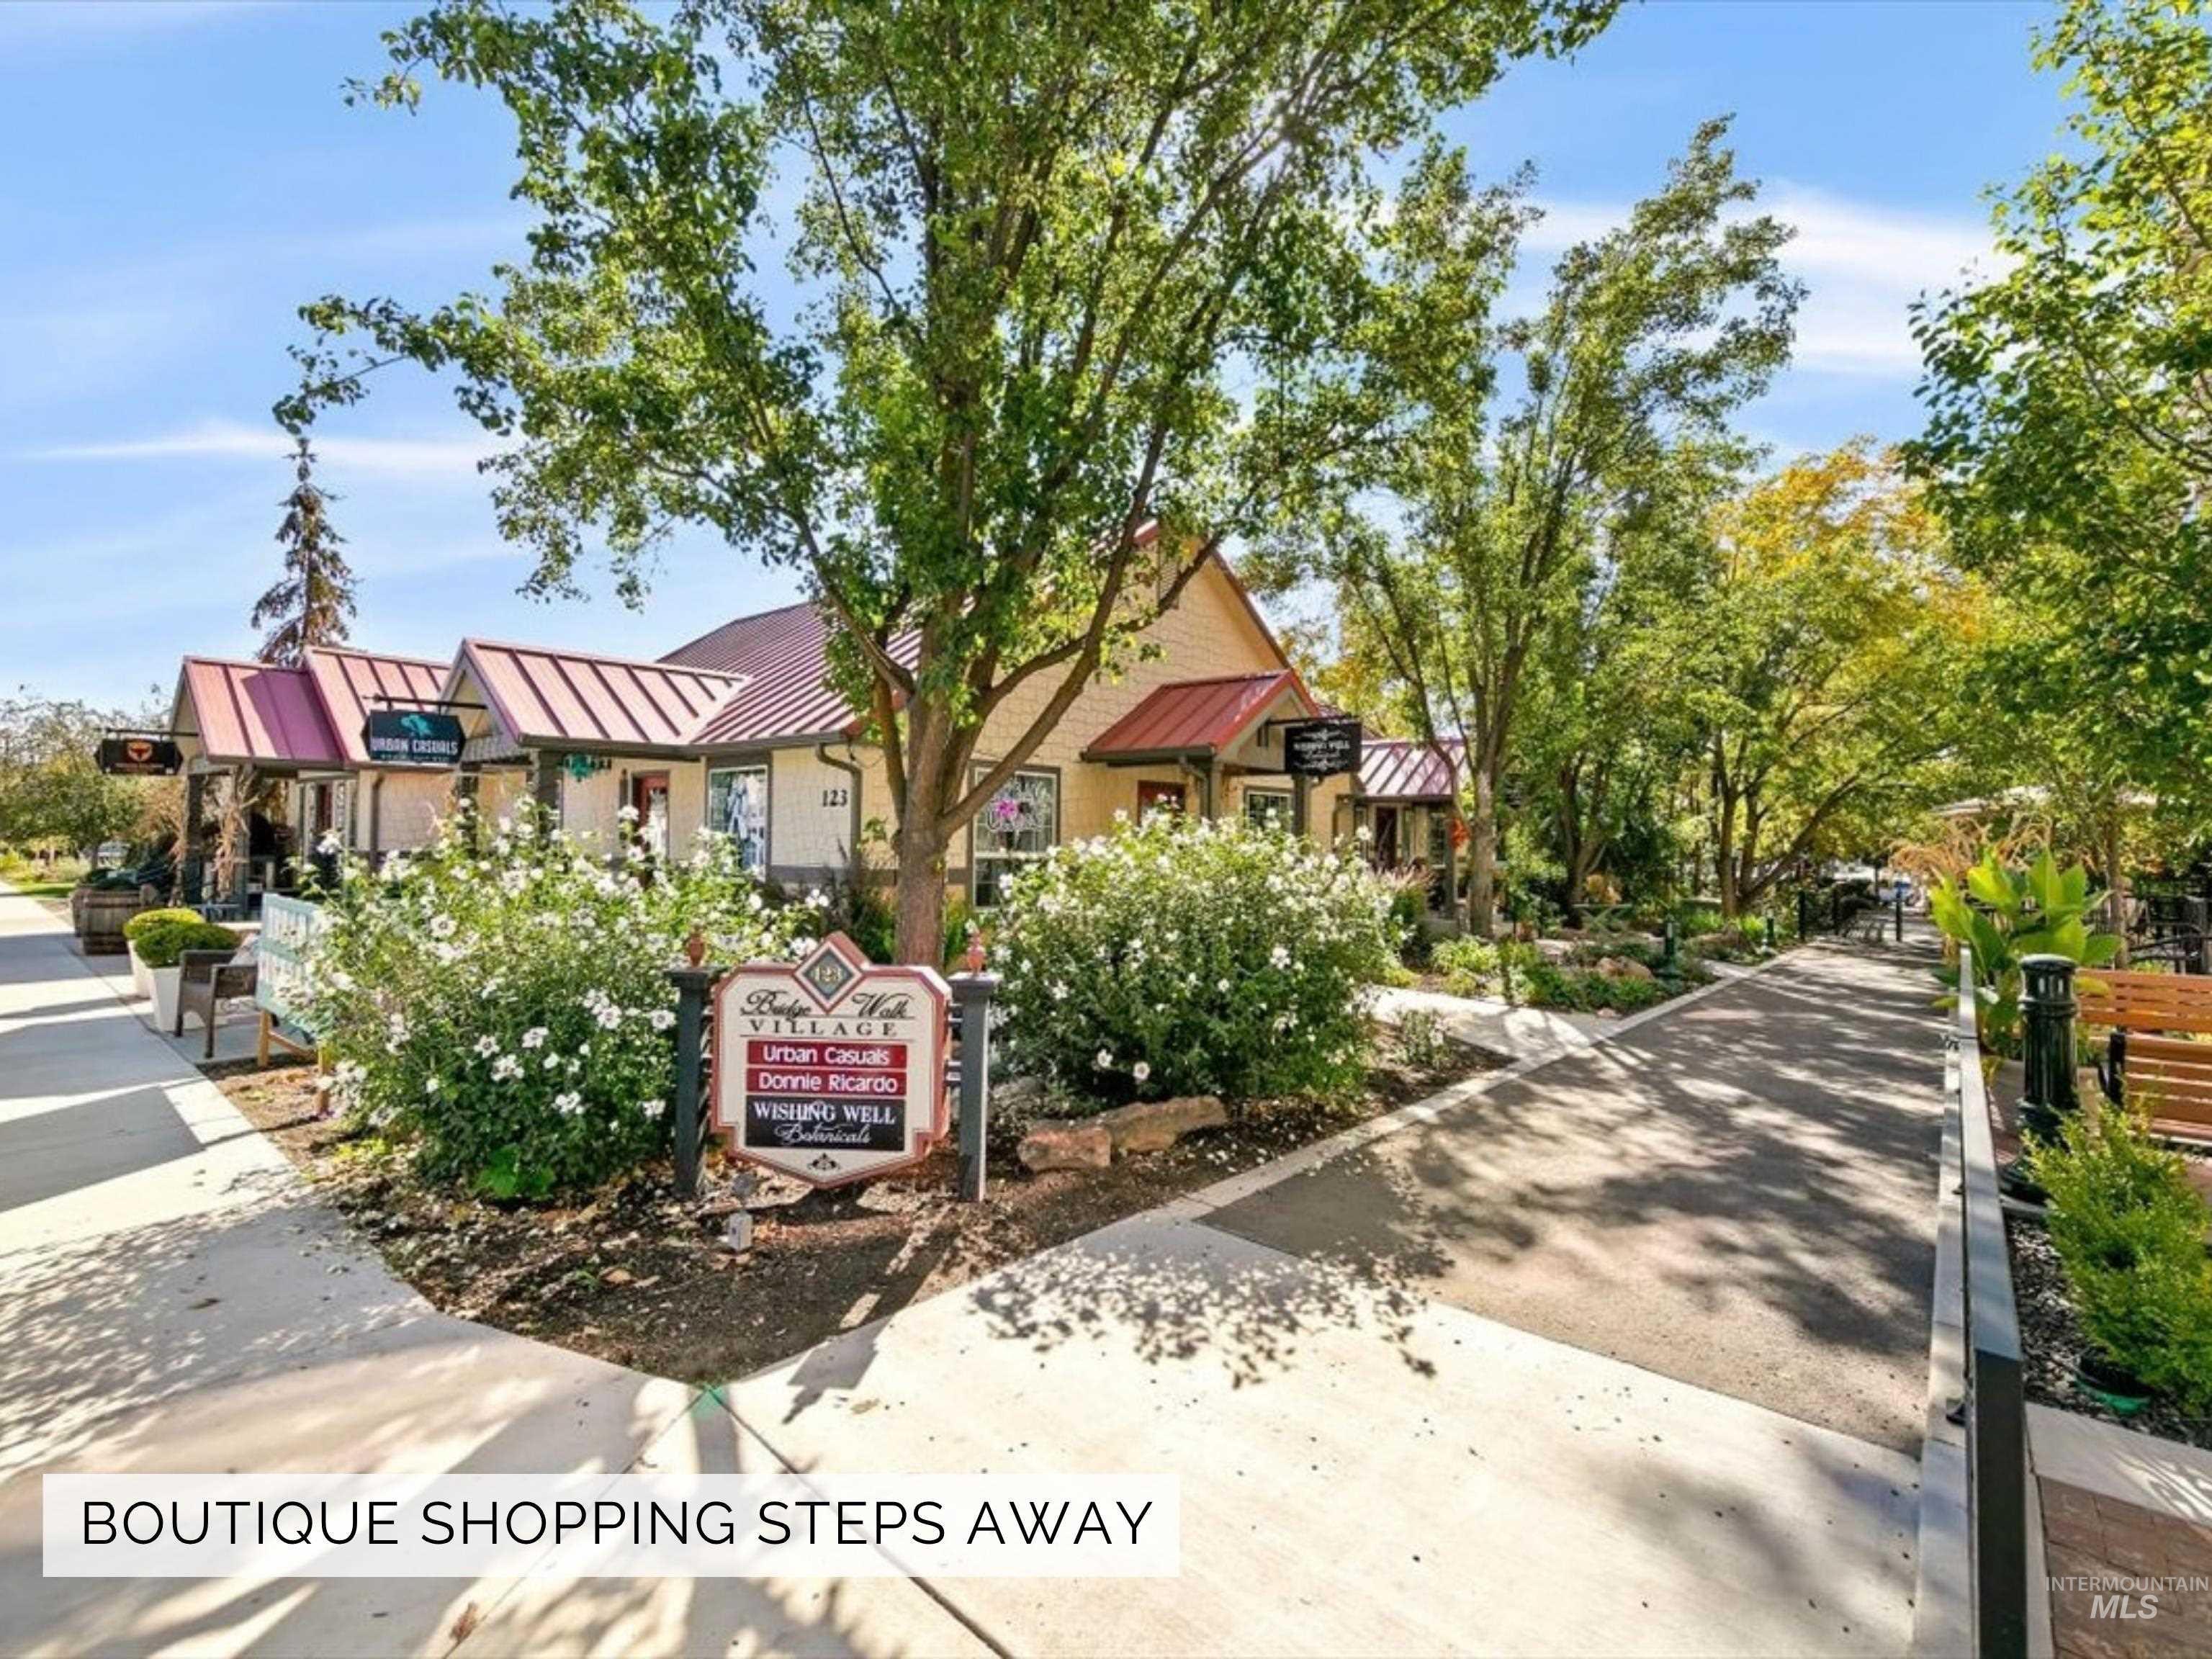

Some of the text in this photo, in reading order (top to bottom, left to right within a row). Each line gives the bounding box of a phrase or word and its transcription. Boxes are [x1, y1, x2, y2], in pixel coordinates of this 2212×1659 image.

[822, 789, 848, 807] 123
[851, 992, 914, 1019] Walk
[750, 1019, 898, 1037] VILLAGE
[763, 1045, 890, 1066] Urban Casuals
[758, 1071, 898, 1093] Donnie Ricardo
[754, 1099, 896, 1124] WISHING WELL
[774, 1121, 872, 1146] Botanicals
